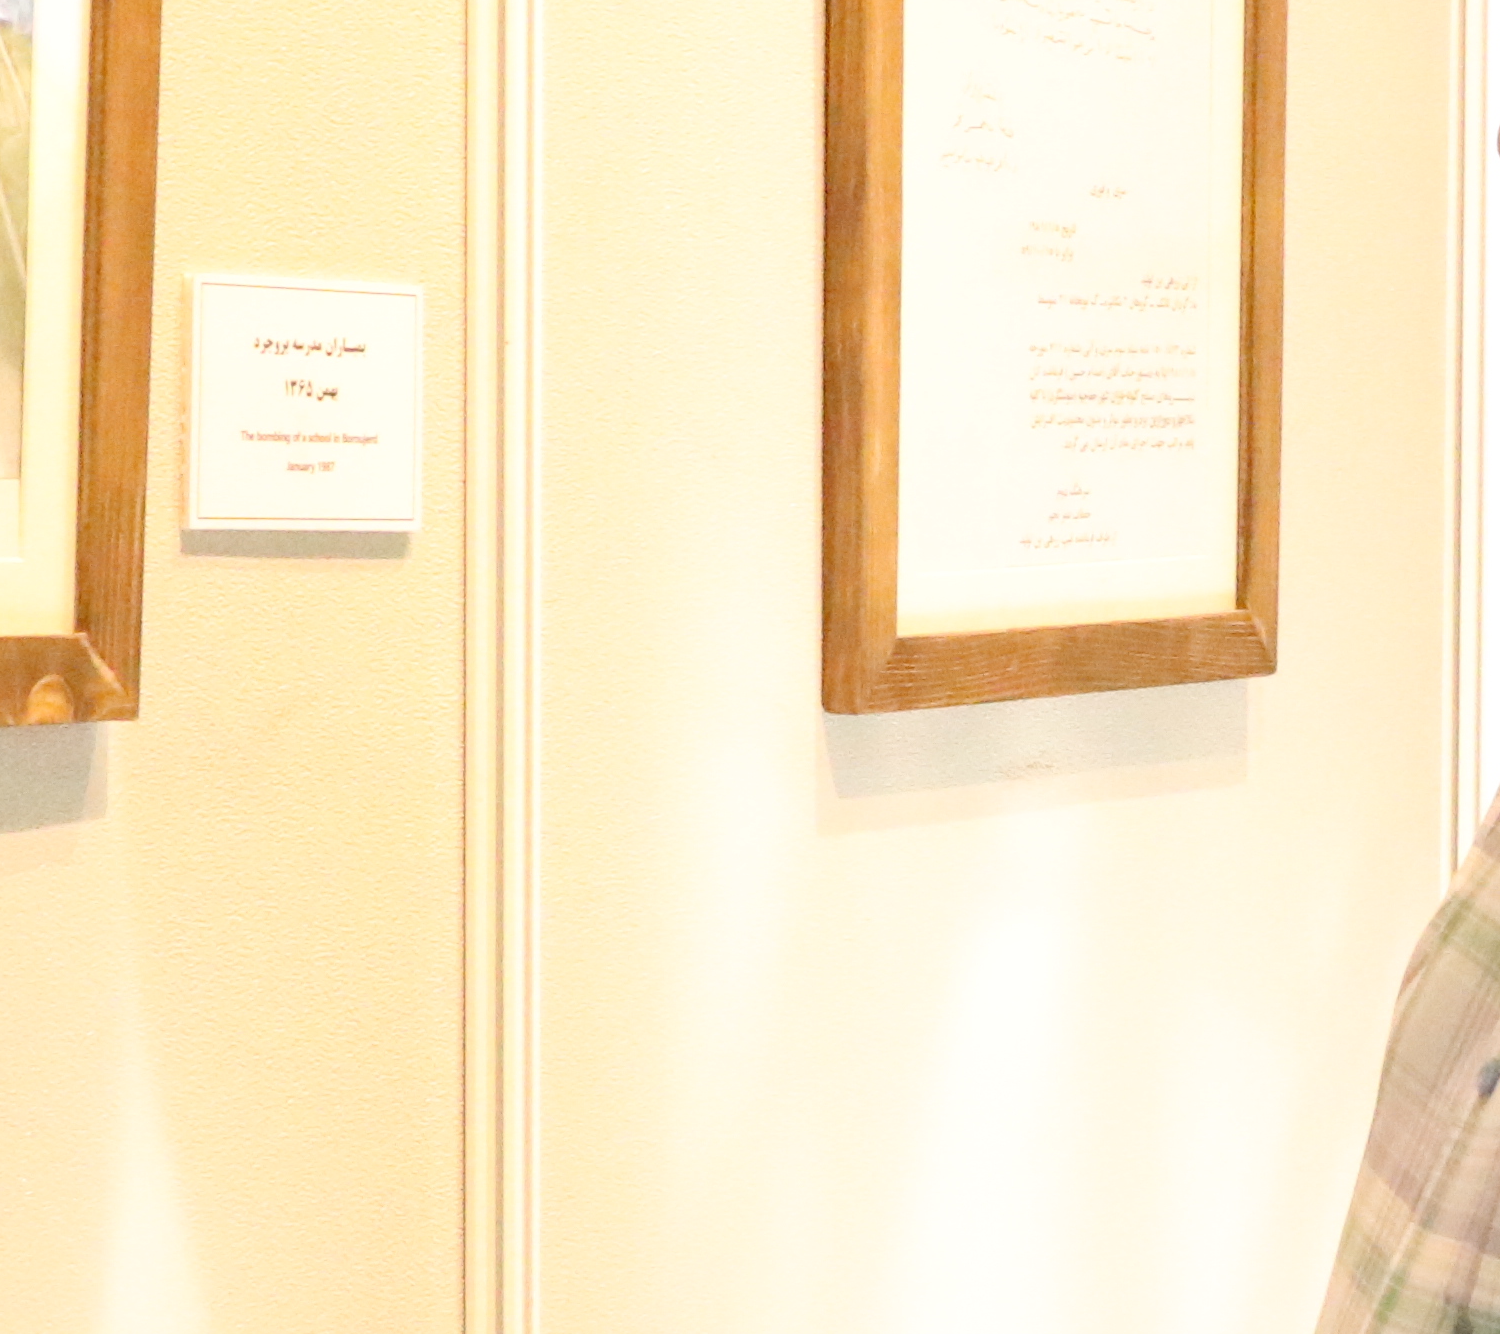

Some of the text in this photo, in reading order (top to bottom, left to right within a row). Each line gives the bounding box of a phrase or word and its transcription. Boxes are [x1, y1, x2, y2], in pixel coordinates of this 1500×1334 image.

[253, 337, 367, 357] بمباران مدرسه بروجرد
[316, 386, 338, 401] بهمن
[240, 430, 255, 442] The
[256, 431, 291, 445] bombing
[293, 431, 301, 442] of
[308, 432, 332, 443] school
[333, 433, 340, 443] in
[286, 461, 315, 474] January
